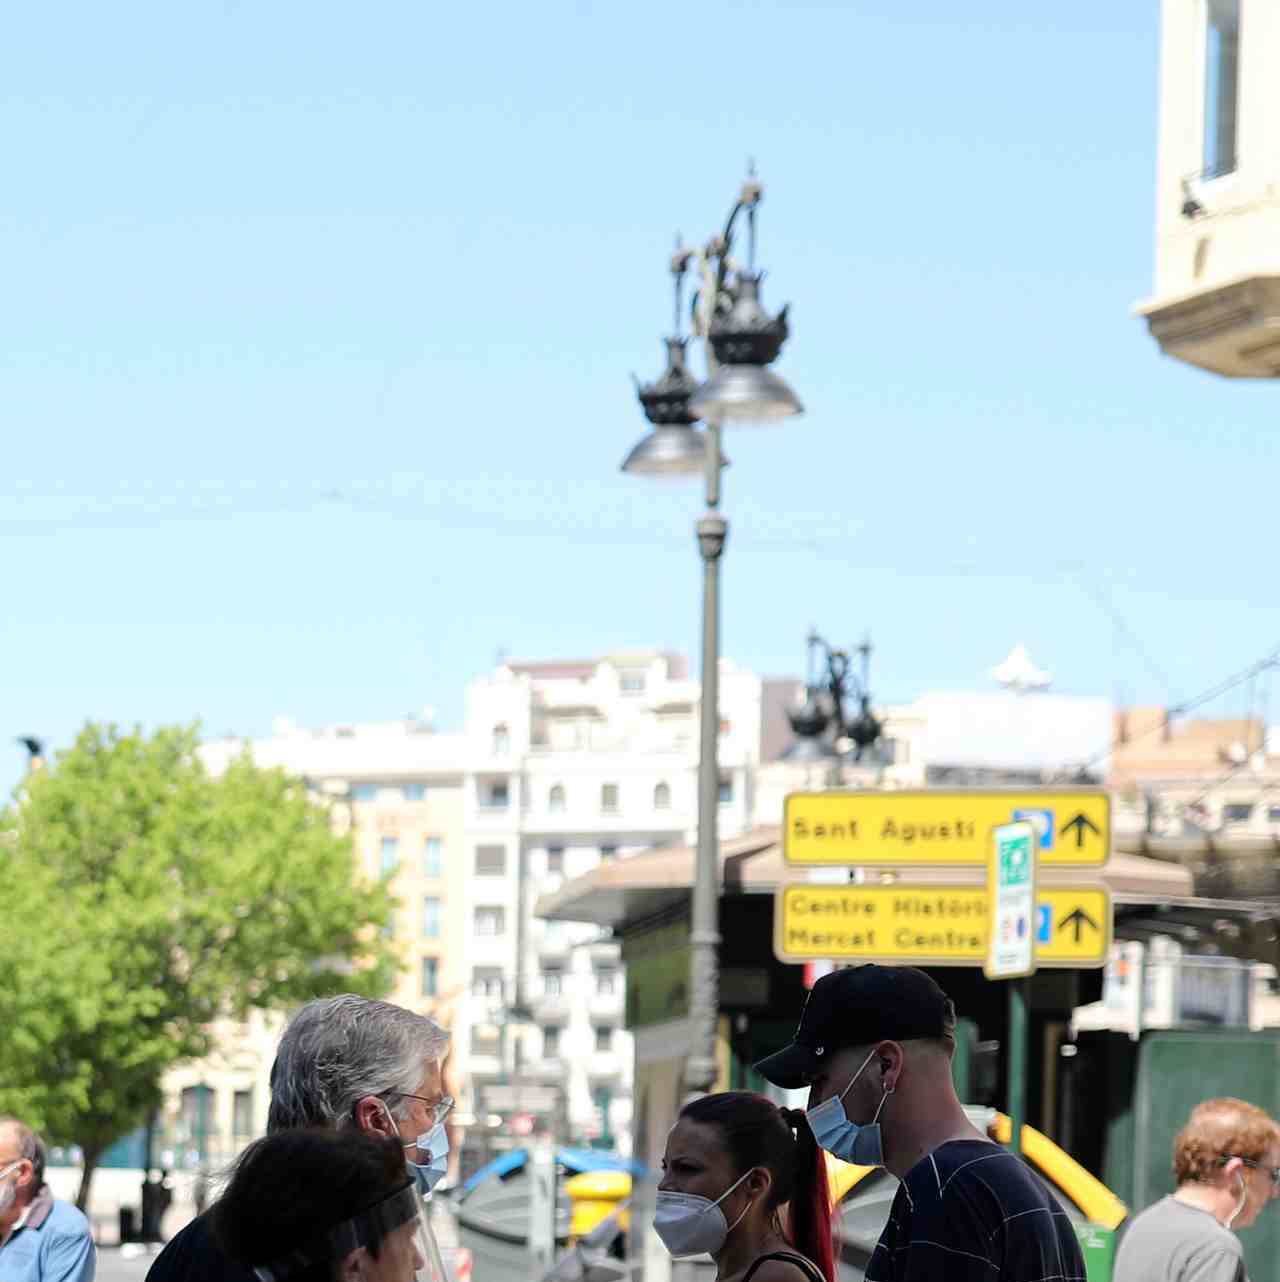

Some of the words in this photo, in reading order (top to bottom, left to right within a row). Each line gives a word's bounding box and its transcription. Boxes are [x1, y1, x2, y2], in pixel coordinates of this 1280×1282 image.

[794, 819, 858, 840] Sant
[791, 895, 876, 916] Centre
[789, 928, 876, 947] Mercat
[895, 928, 986, 948] Centra
